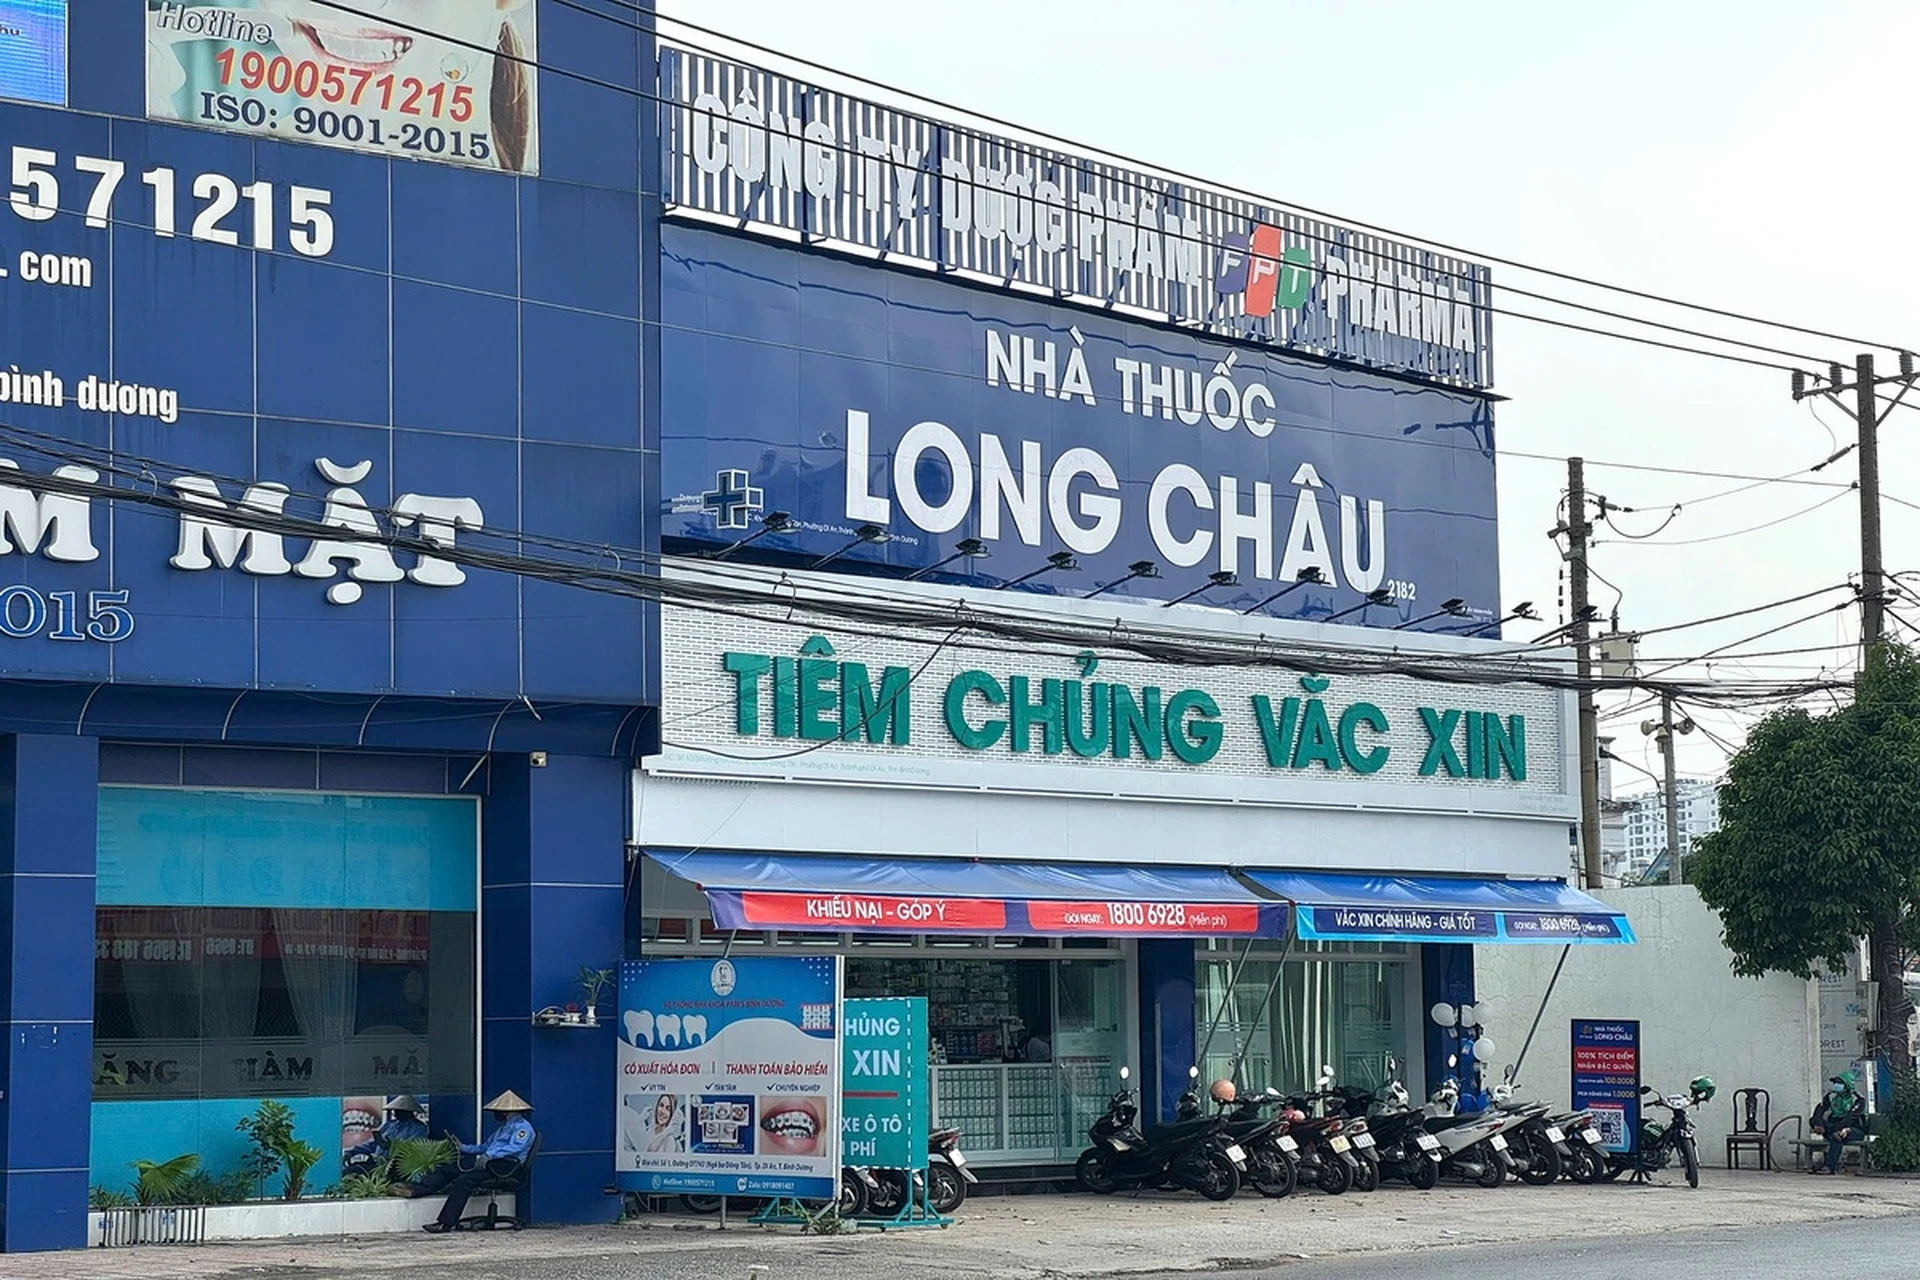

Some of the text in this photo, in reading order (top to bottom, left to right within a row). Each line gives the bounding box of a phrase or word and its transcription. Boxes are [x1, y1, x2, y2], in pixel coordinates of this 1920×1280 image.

[157, 2, 273, 45] Hotline
[215, 47, 475, 122] 1900571215
[200, 92, 491, 160] ISO: 9001-2015
[10, 146, 334, 258] 571215
[693, 87, 1475, 354] CÔNG TY DƯỢC PHẨM FPT PHARMA
[20, 251, 91, 287] com
[78, 375, 178, 423] dương
[985, 326, 1277, 437] NHÀ THUỐC
[845, 408, 1385, 593] LONG CHÂU
[169, 456, 484, 604] MẶT
[1387, 579, 1416, 600] 2182
[723, 635, 910, 746] TIÊM
[944, 650, 1224, 764] CHỦNG
[1417, 706, 1527, 781] XIN
[807, 895, 852, 918] KHIẾU
[855, 902, 882, 925] NẠI
[897, 898, 932, 920] GÓP
[936, 899, 946, 920] Ý
[1107, 903, 1143, 925] 1800
[1148, 903, 1185, 926] 6928
[1358, 912, 1374, 927] XIN
[624, 1060, 701, 1075] CÓ XUẤT HÓA ĐƠN
[726, 1060, 828, 1076] THANH TOÁN BẢO HIỂM
[852, 1050, 900, 1076] XIN
[864, 1114, 877, 1133] Ô
[881, 1114, 902, 1133] TÔ
[851, 1137, 876, 1156] PHÍ
